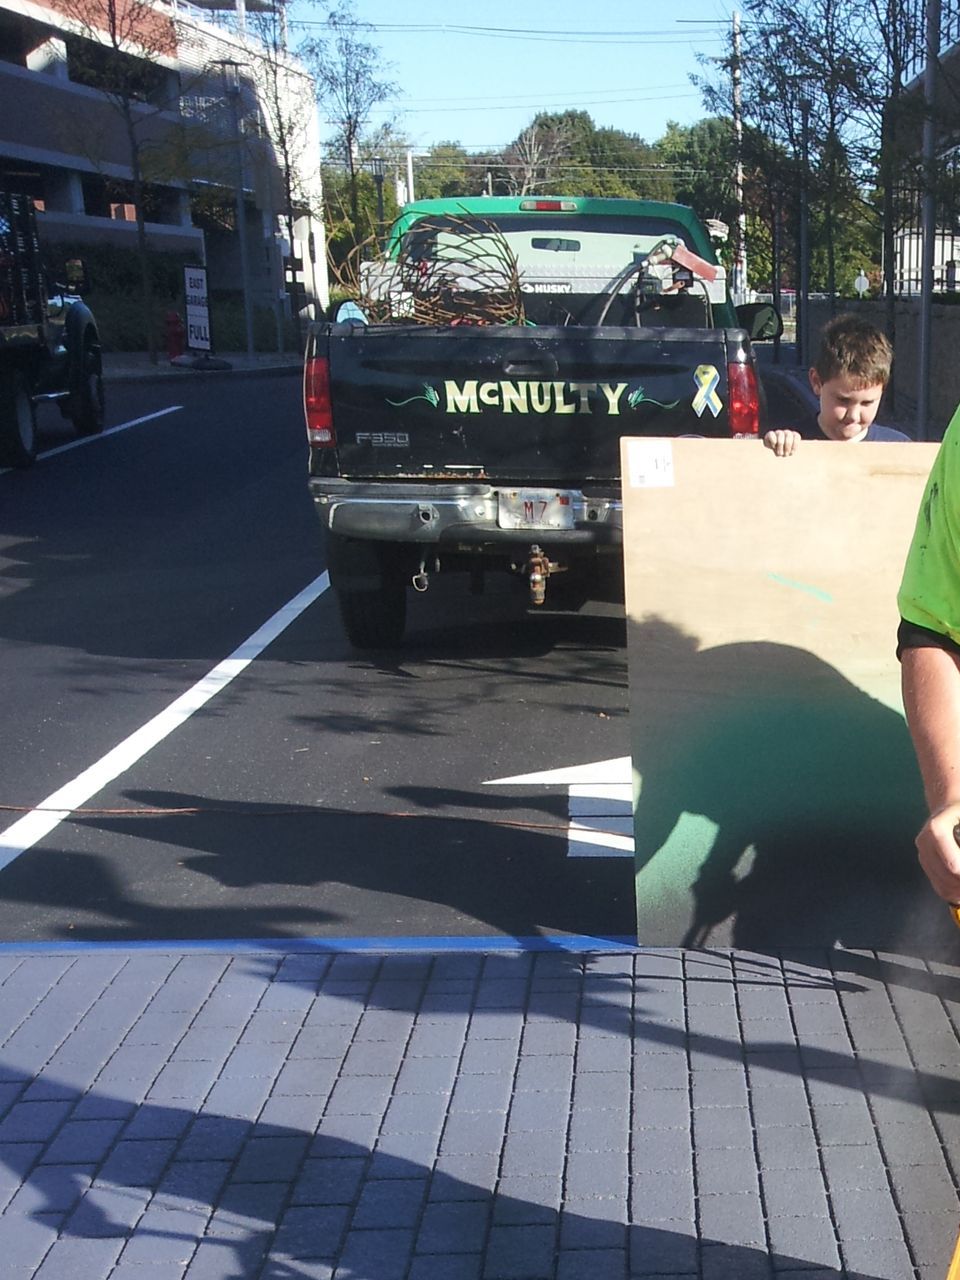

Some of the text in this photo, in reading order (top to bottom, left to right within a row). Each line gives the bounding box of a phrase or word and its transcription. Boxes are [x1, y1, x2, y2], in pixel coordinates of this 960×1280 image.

[189, 277, 204, 290] EAST
[534, 284, 571, 294] HUSKY
[189, 324, 209, 341] FULL
